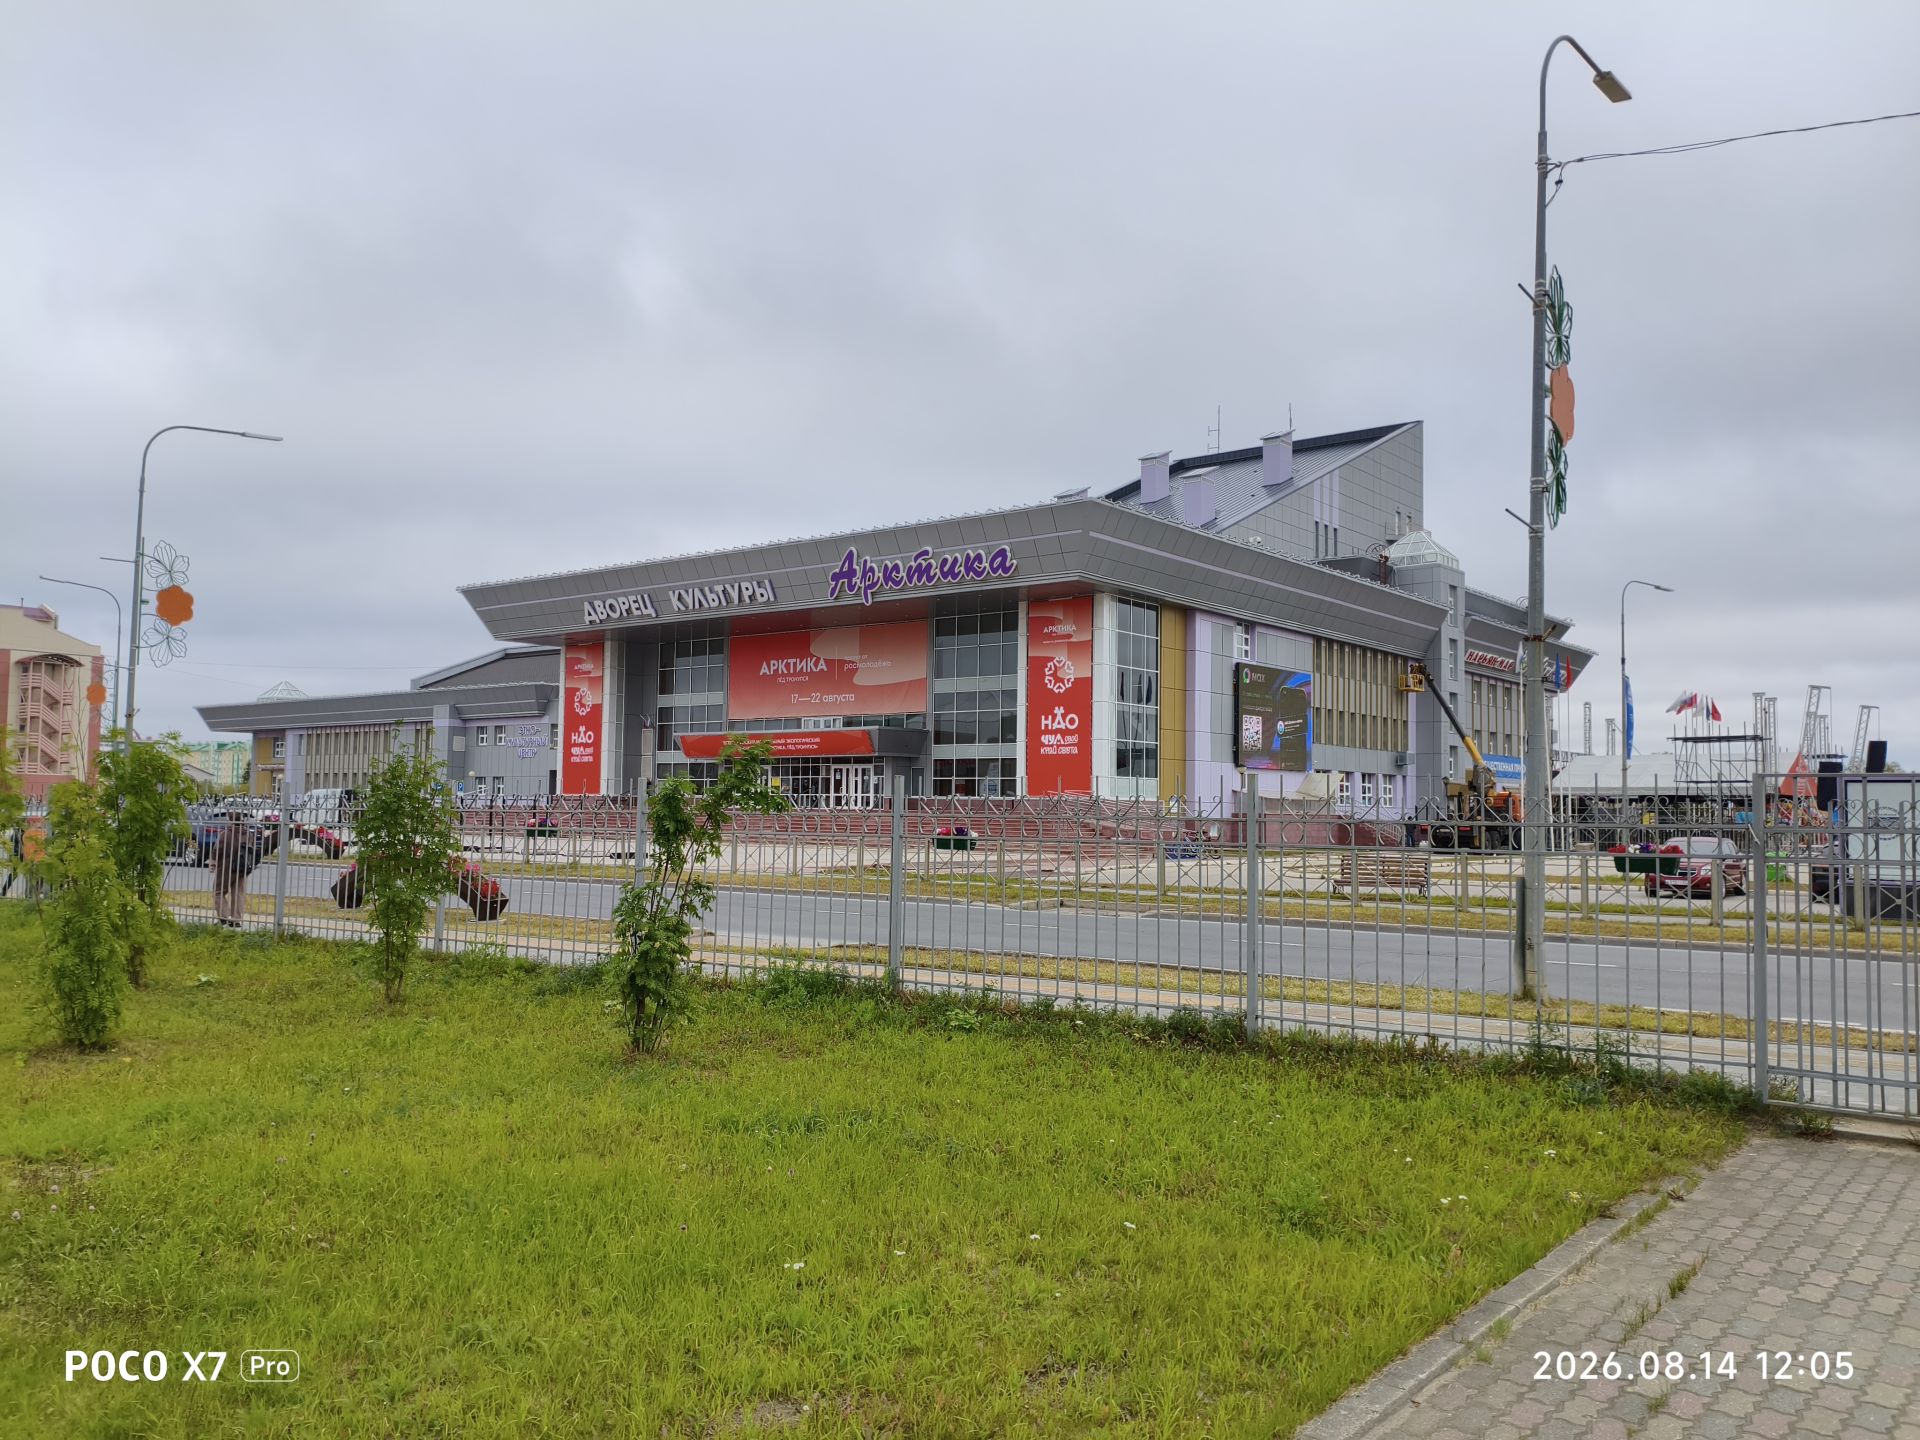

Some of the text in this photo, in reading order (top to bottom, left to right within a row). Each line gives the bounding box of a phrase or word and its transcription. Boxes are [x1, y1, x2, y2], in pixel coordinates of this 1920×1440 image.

[828, 545, 1017, 606] Арктика
[583, 578, 777, 624] ДВОРЕЦ КУЛЬТУРЫ
[1043, 624, 1077, 633] АРКТИКА
[759, 657, 828, 676] АРКТИКА
[822, 693, 855, 705] августа
[1041, 706, 1079, 730] НАО
[571, 725, 594, 744] НАО
